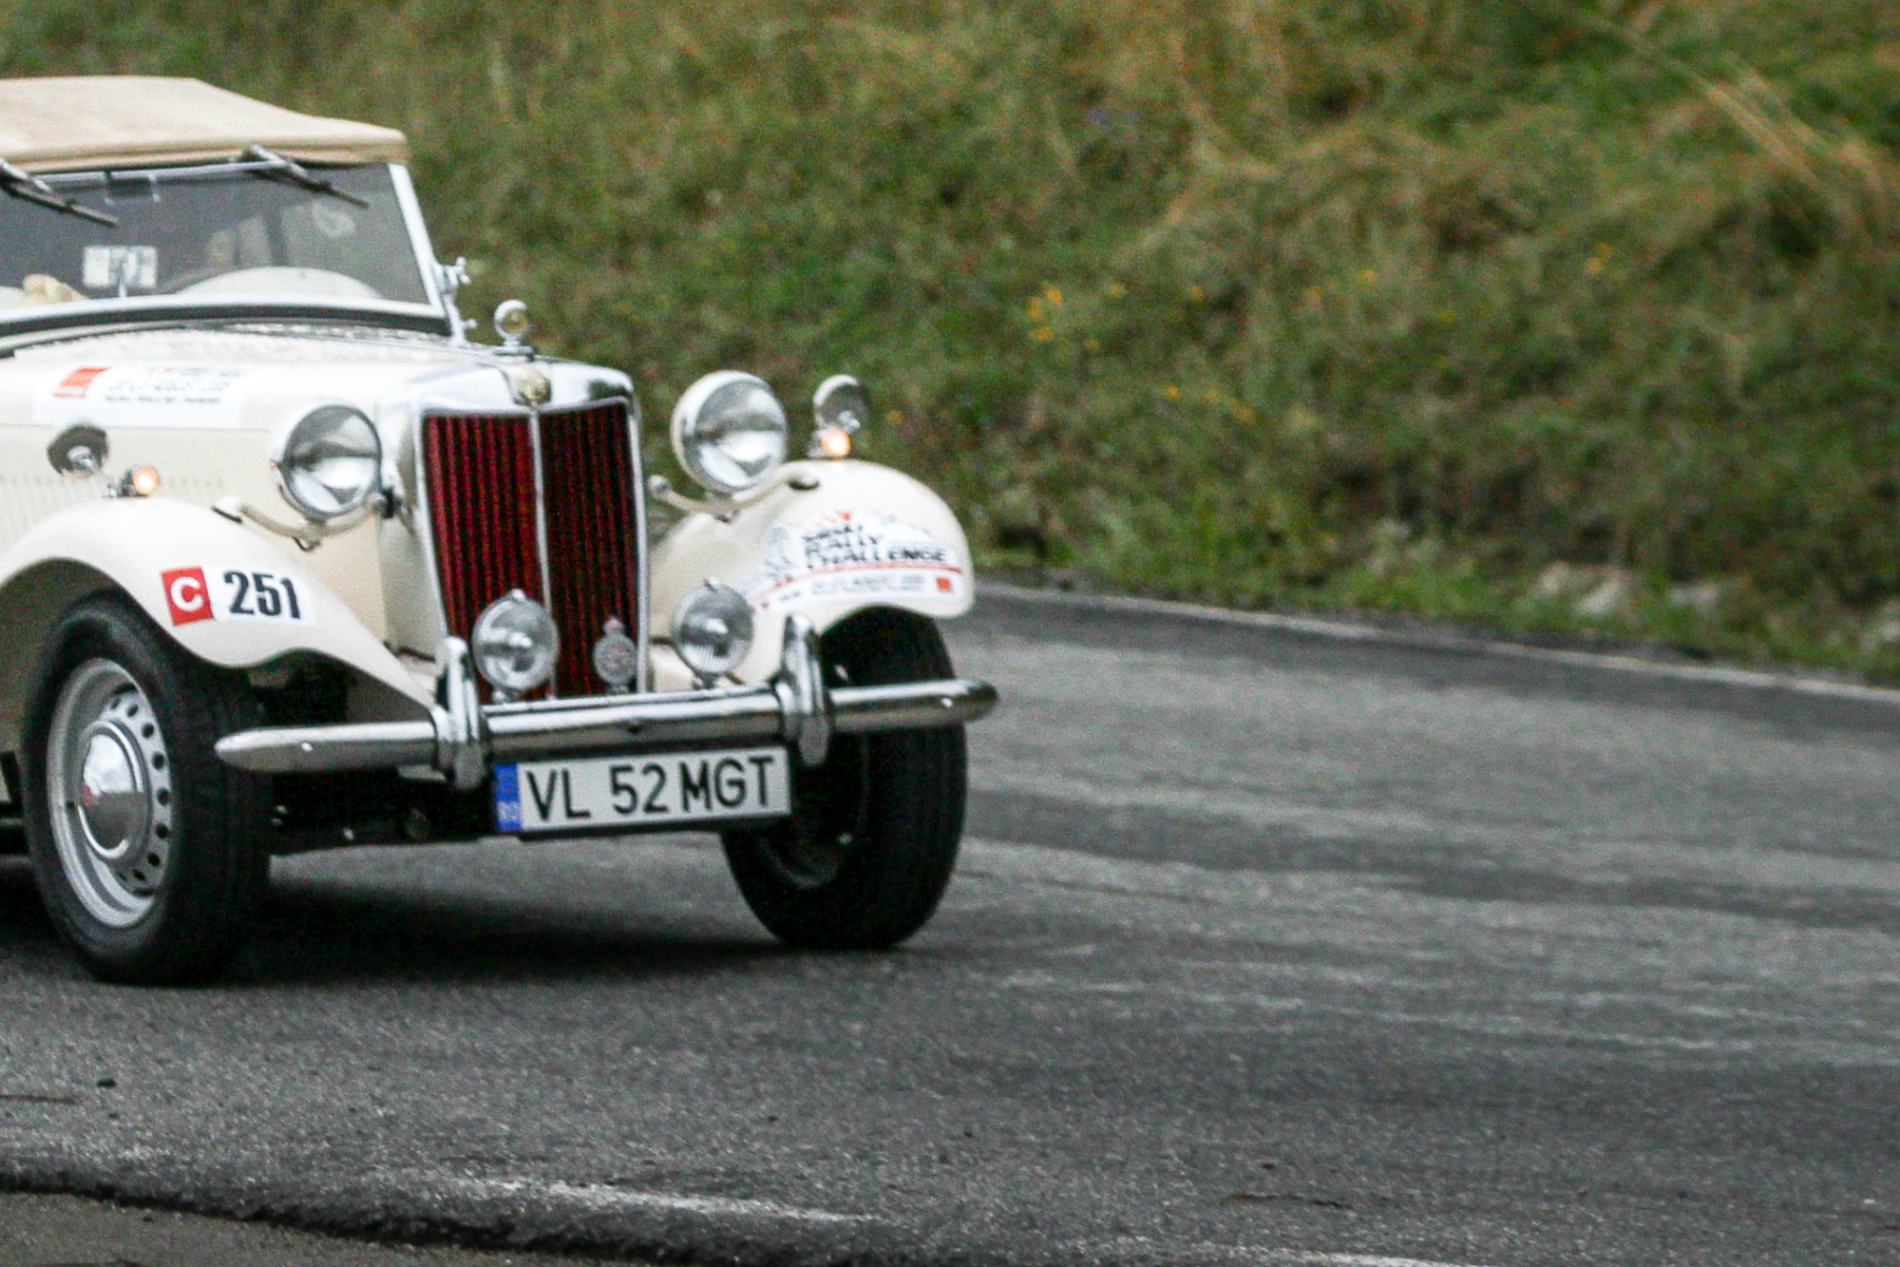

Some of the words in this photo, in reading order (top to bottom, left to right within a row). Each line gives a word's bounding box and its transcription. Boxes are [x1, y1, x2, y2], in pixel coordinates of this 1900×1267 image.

[170, 576, 205, 612] C
[222, 570, 301, 620] 251
[526, 767, 592, 822] VL
